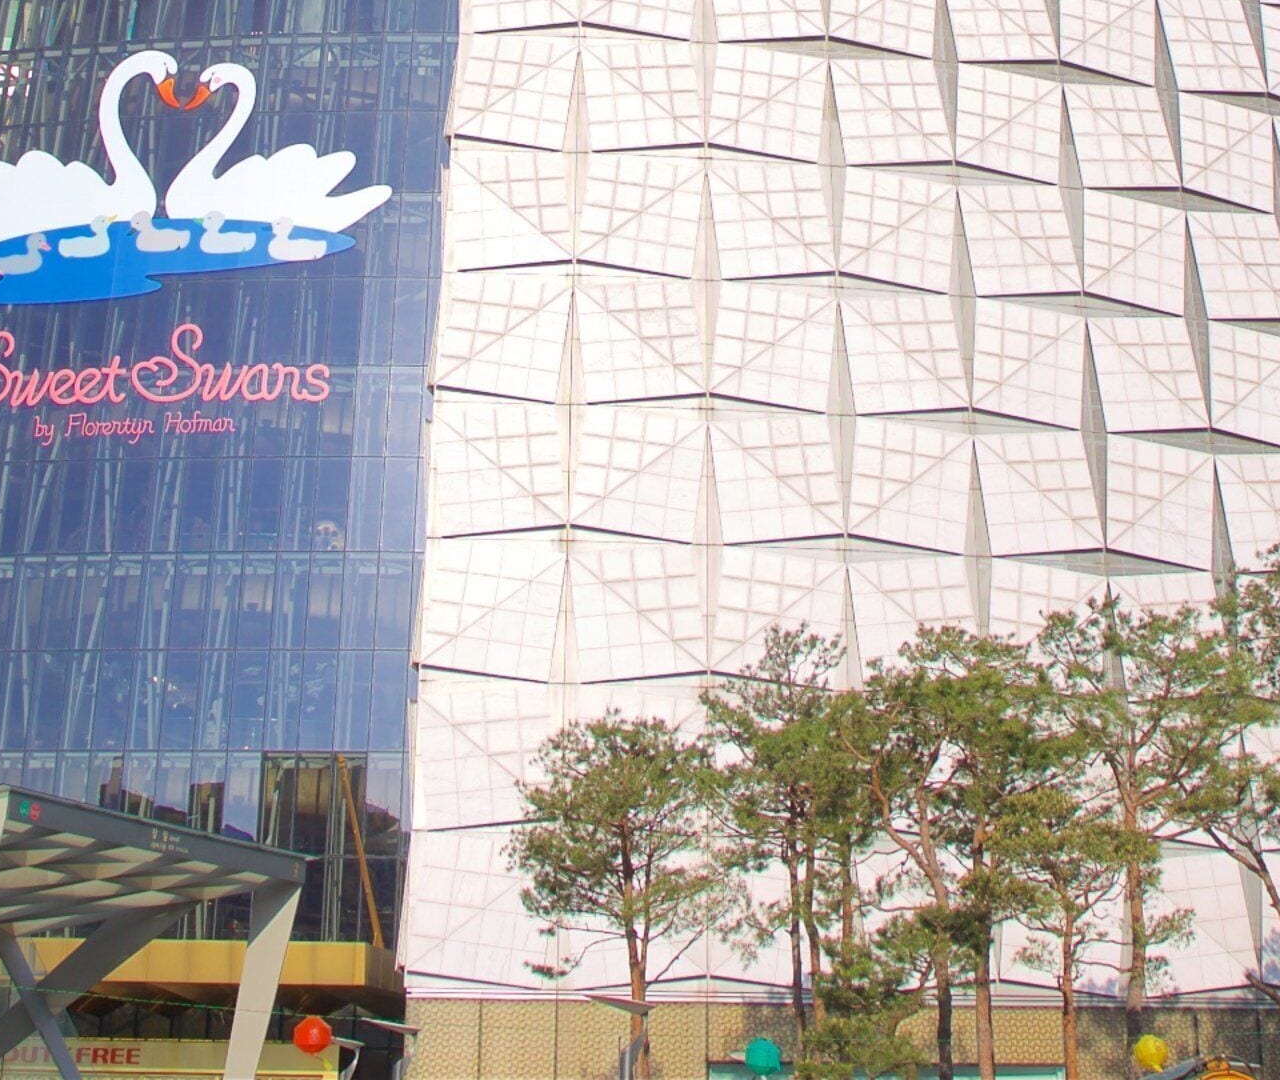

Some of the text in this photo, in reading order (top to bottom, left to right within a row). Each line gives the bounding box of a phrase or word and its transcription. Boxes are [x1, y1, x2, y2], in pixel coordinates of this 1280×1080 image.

[130, 323, 330, 403] Swans
[33, 411, 236, 446] by Florentijn Hofman
[3, 1046, 141, 1065] DUT FREE
